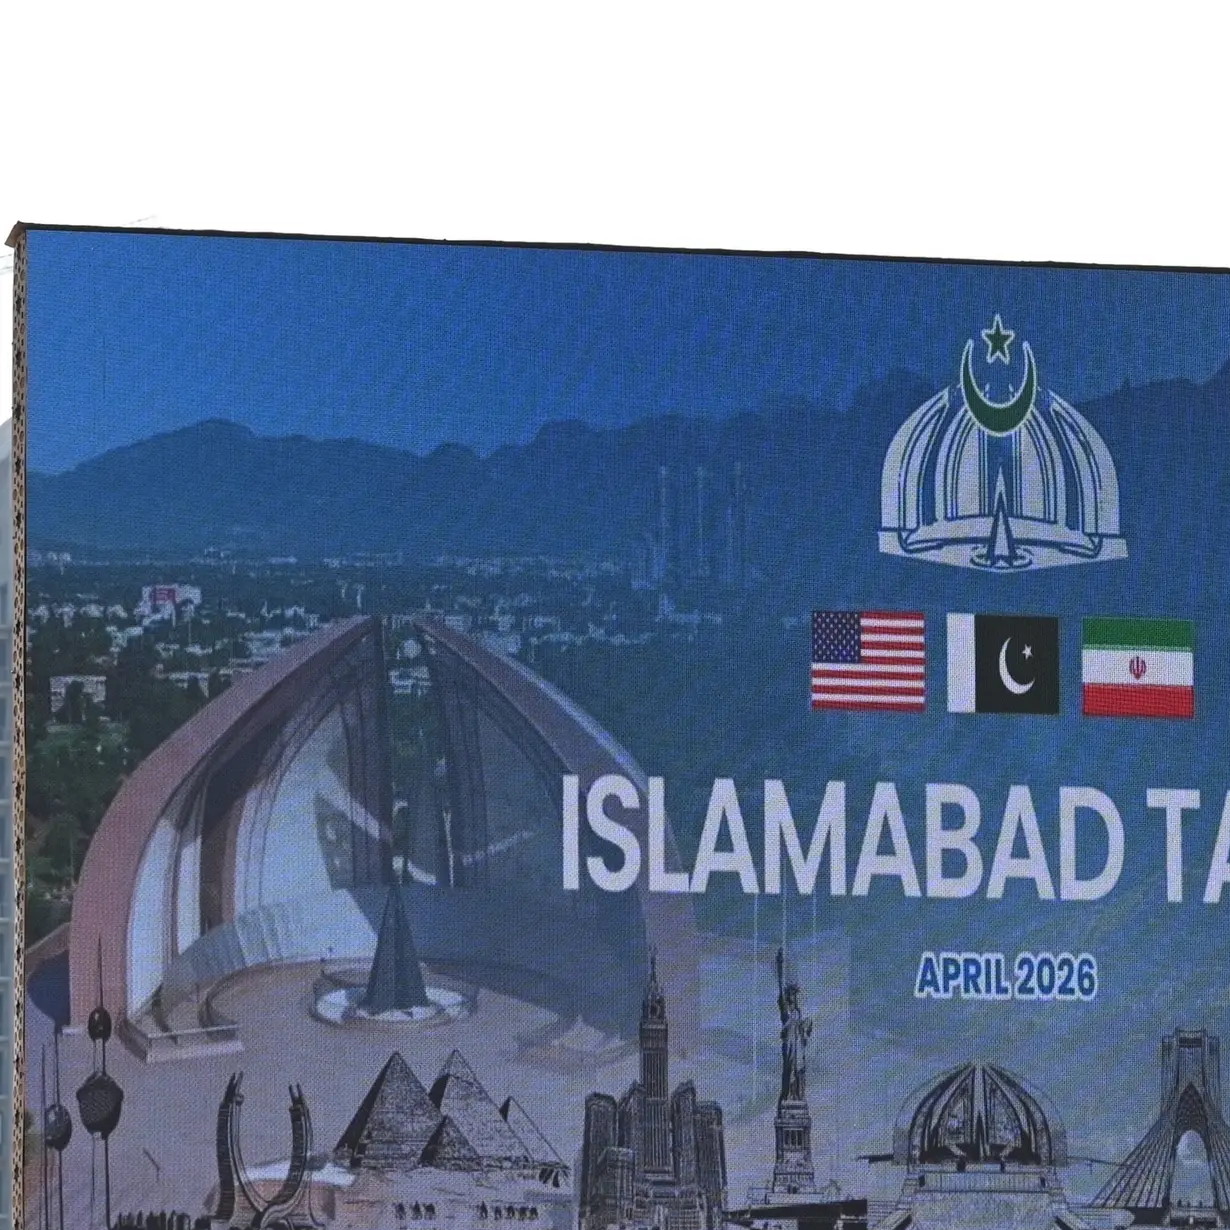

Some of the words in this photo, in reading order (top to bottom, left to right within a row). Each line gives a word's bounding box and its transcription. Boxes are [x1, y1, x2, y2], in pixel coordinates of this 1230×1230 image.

[562, 772, 1126, 903] ISLAMABAD
[915, 951, 1010, 999] APRIL
[1016, 952, 1099, 1001] 2026
